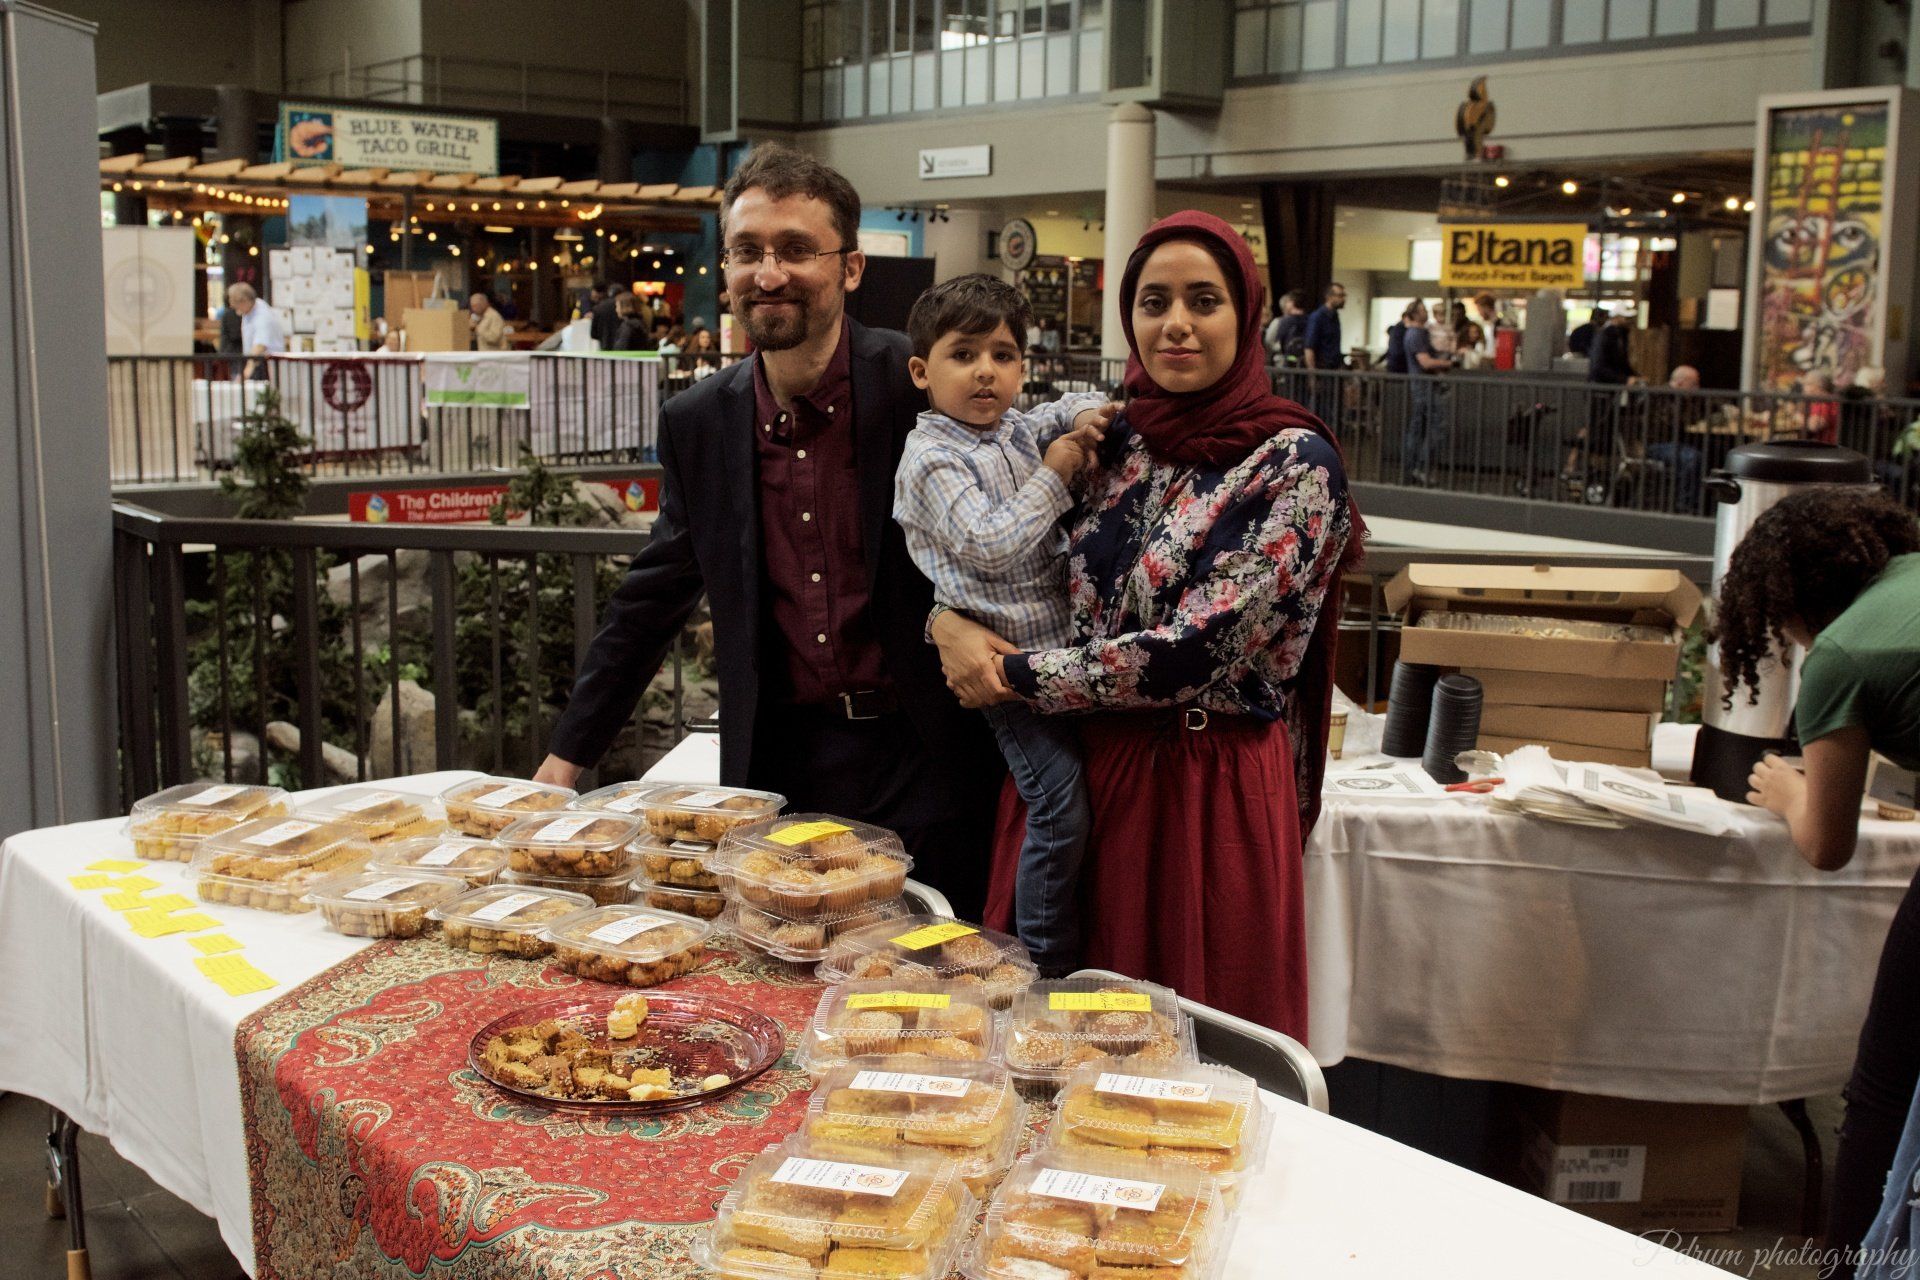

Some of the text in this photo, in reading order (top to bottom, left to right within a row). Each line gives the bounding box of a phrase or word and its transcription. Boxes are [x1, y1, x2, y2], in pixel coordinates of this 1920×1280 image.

[350, 119, 480, 144] BLUE WATER
[357, 138, 471, 161] TACO GRILL
[1451, 230, 1573, 266] Eltana
[1530, 269, 1574, 283] Bagels
[397, 494, 425, 510] The
